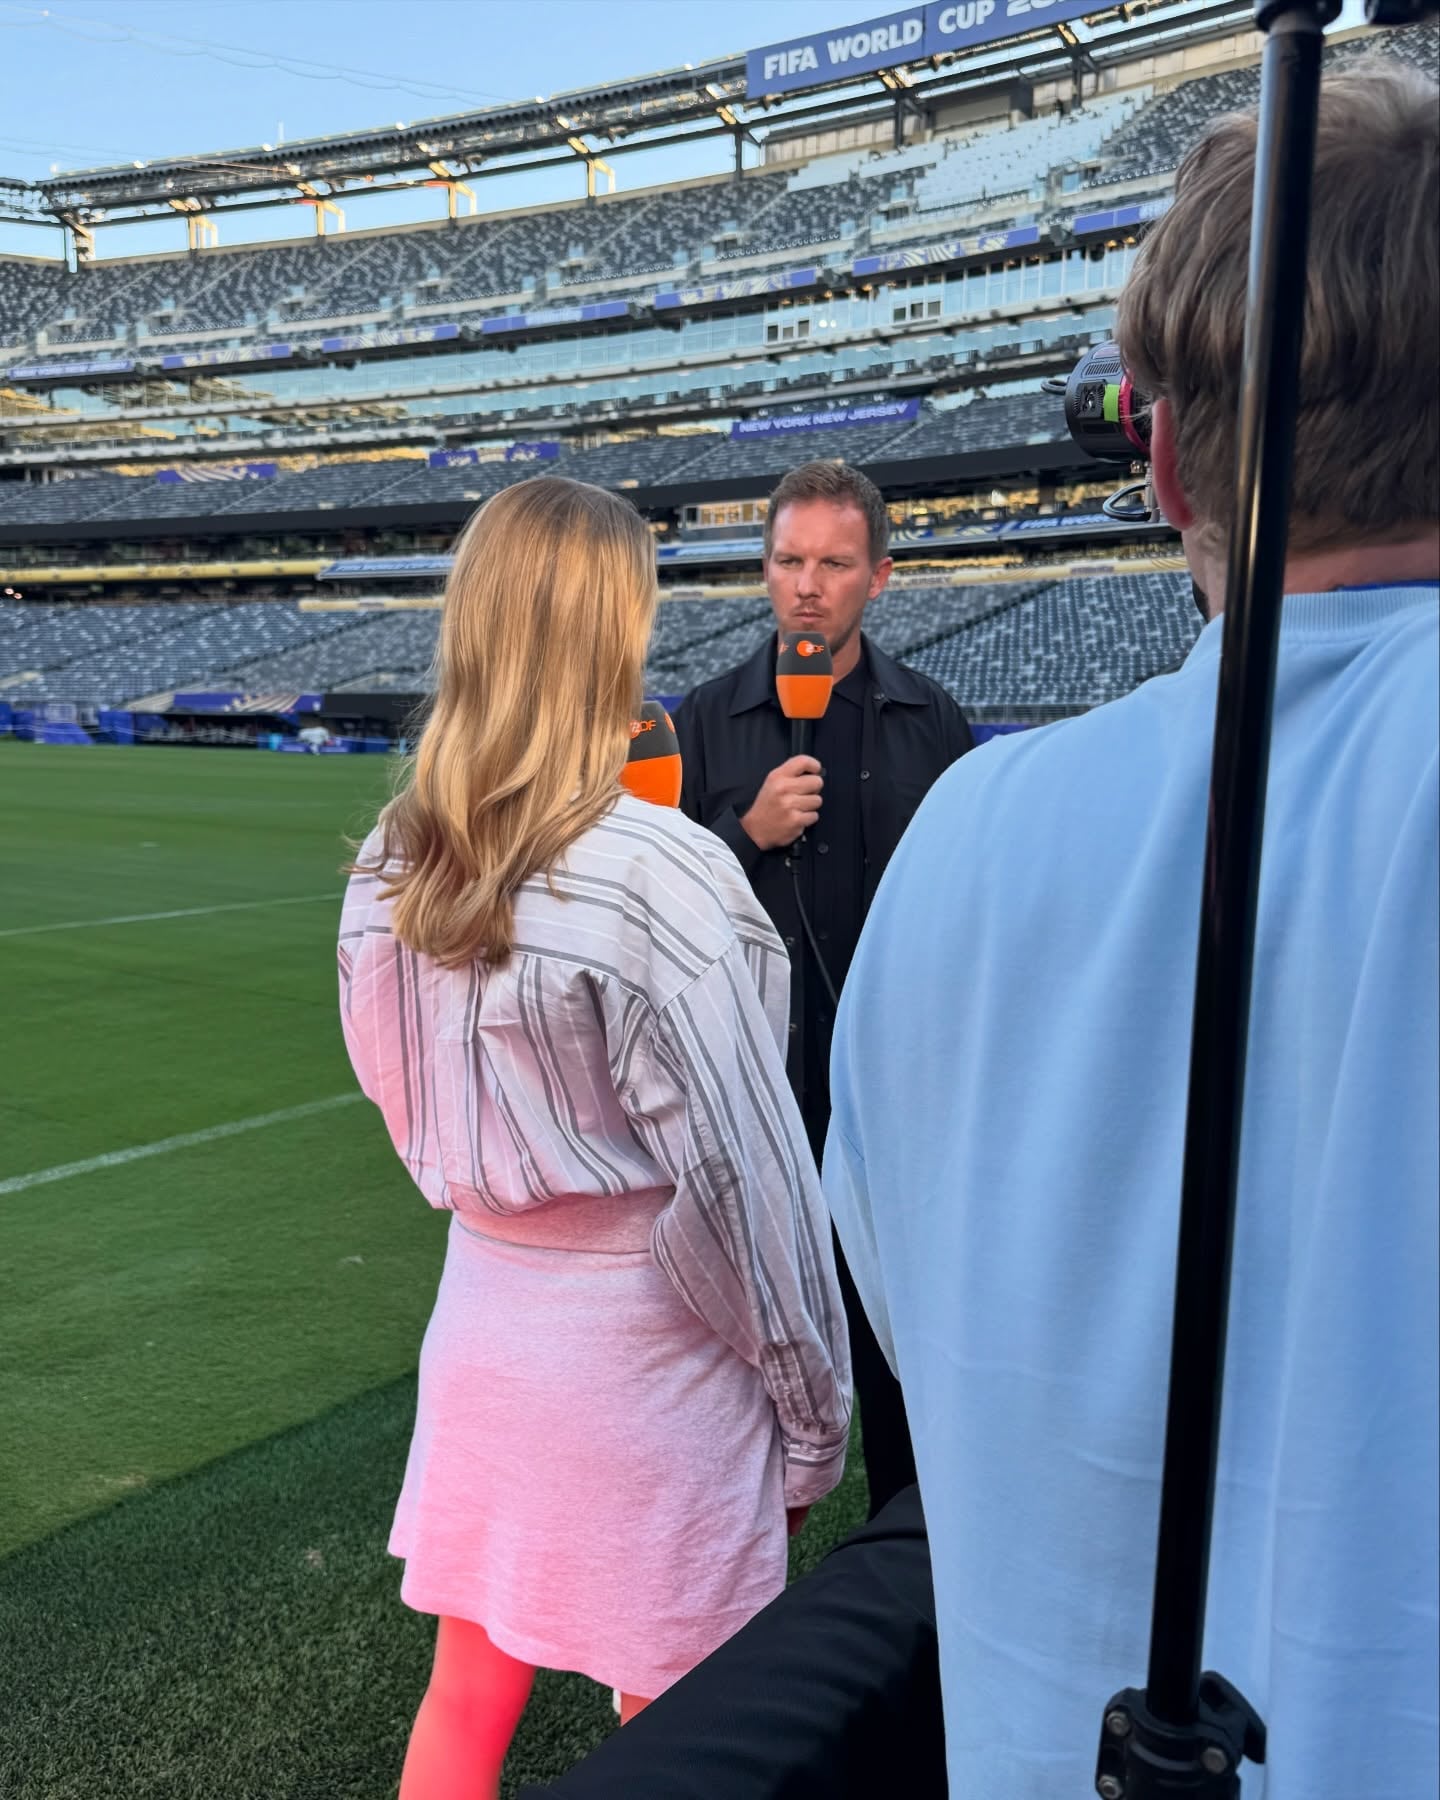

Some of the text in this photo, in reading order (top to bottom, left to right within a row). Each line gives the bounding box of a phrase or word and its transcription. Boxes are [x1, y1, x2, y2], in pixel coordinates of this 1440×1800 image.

[764, 47, 818, 80] FIFA
[827, 19, 923, 63] WORLD
[938, 0, 996, 34] CUP
[739, 403, 908, 433] NEW YORK NEW JERSEY
